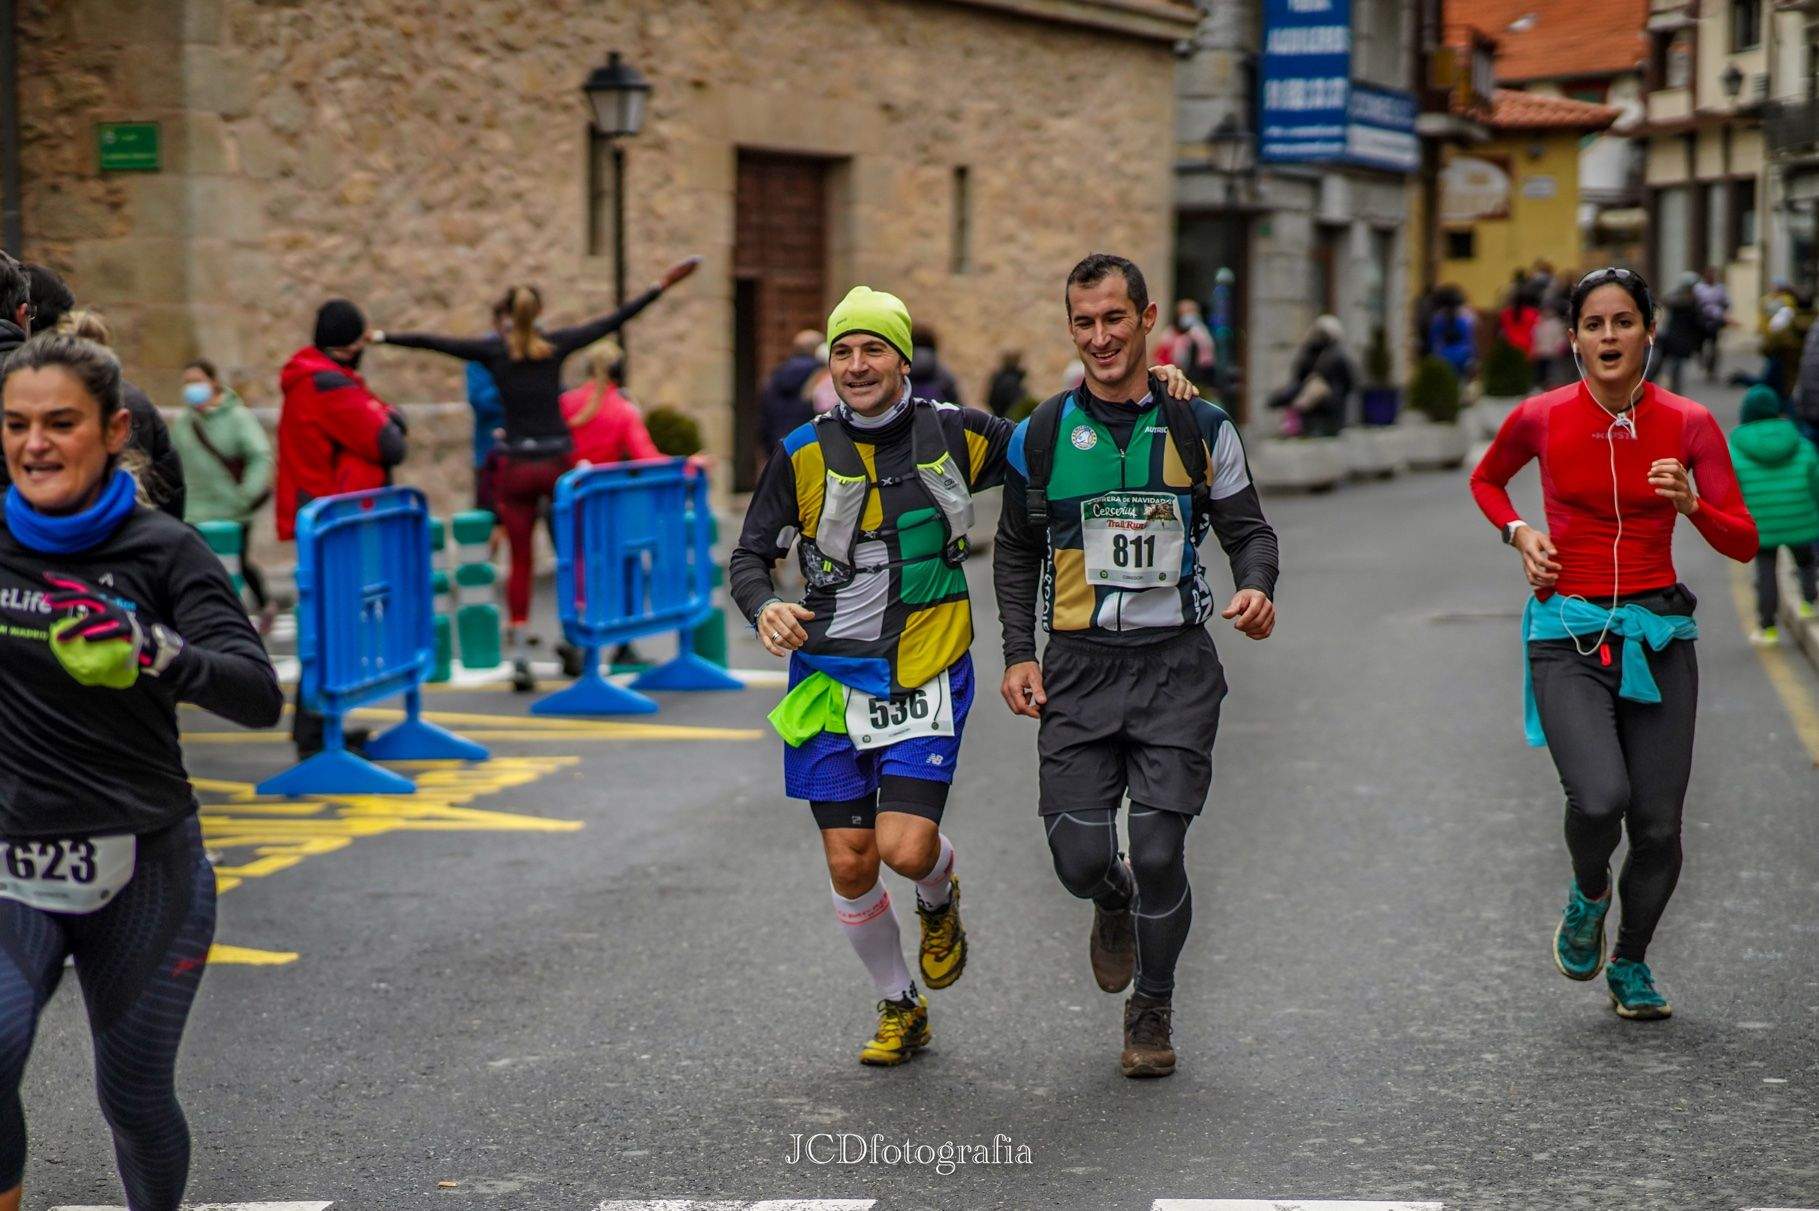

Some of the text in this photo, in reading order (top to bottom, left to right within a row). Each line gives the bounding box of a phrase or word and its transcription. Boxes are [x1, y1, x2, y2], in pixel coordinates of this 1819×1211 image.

[1113, 534, 1155, 568] 811
[868, 689, 929, 730] 536
[6, 840, 97, 884] 623
